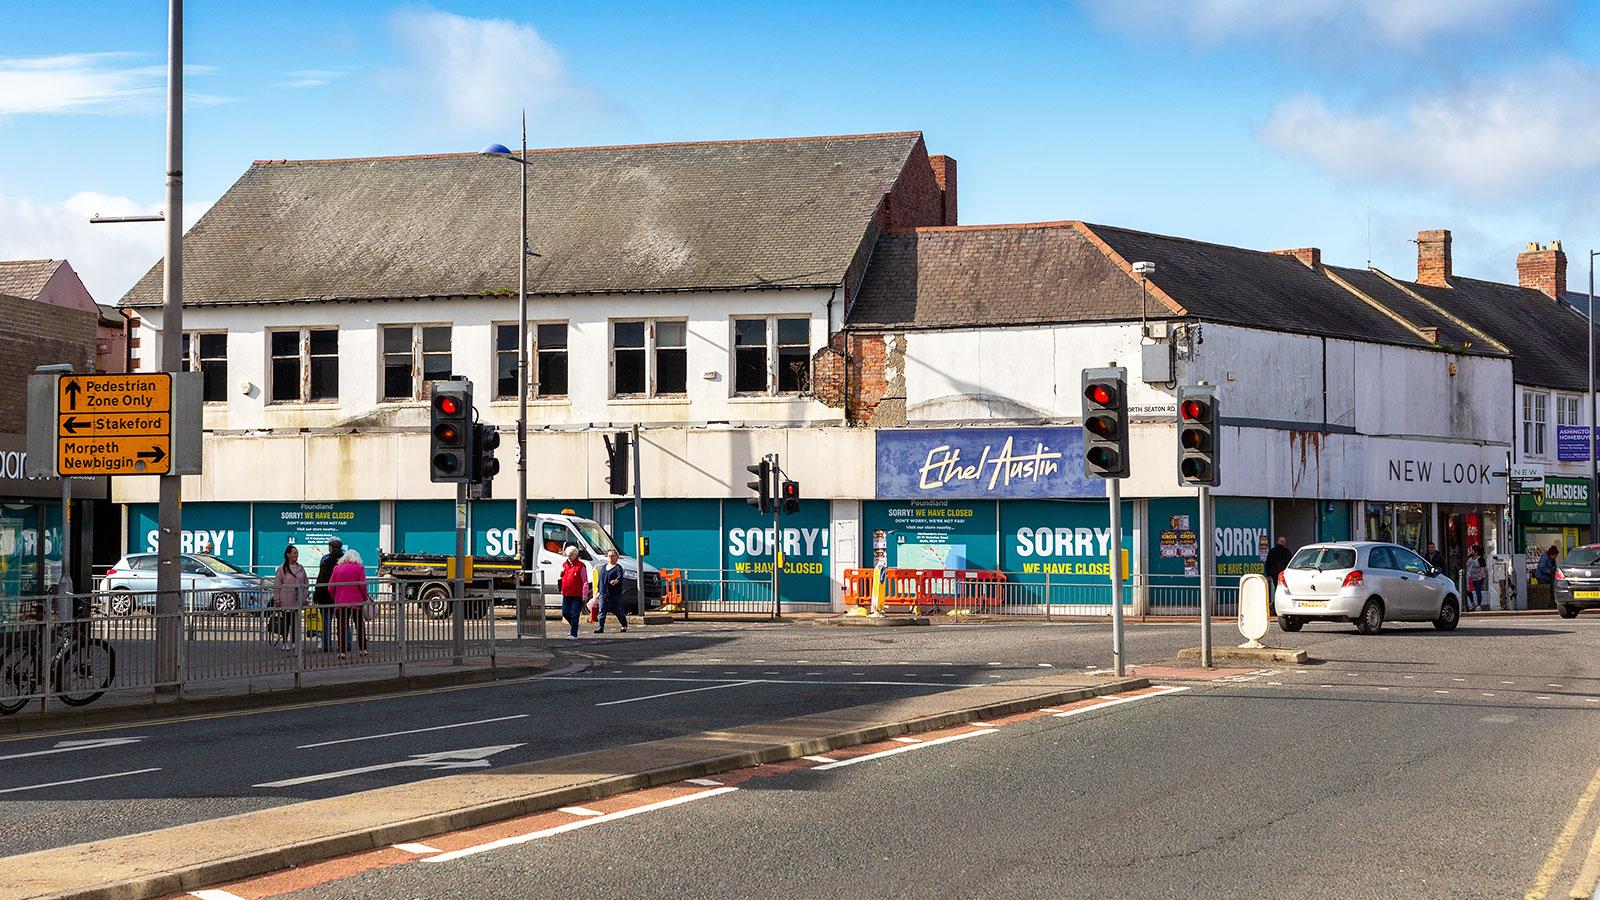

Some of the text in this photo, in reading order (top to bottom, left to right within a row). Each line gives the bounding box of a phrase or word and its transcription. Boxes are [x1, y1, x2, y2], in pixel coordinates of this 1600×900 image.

[86, 381, 156, 392] Pedestrian
[87, 394, 153, 408] Zone Only
[96, 417, 162, 430] Stakeford
[65, 442, 119, 456] Morpeth
[65, 456, 134, 470] Newbiggin
[919, 435, 1062, 490] Ethel Austin
[1389, 459, 1491, 484] NEW LOOK
[1514, 468, 1538, 476] NEW
[1545, 483, 1588, 501] RAMSDENS
[888, 508, 973, 517] SORRY! WE HAVE CLOSED
[147, 529, 235, 556] SRRY!
[729, 527, 829, 557] SORRY!
[735, 562, 823, 574] WE HAV CLOSED
[1023, 563, 1110, 575] WE HAVE CLOSE
[1217, 562, 1265, 575] WE HAVE CLOSED
